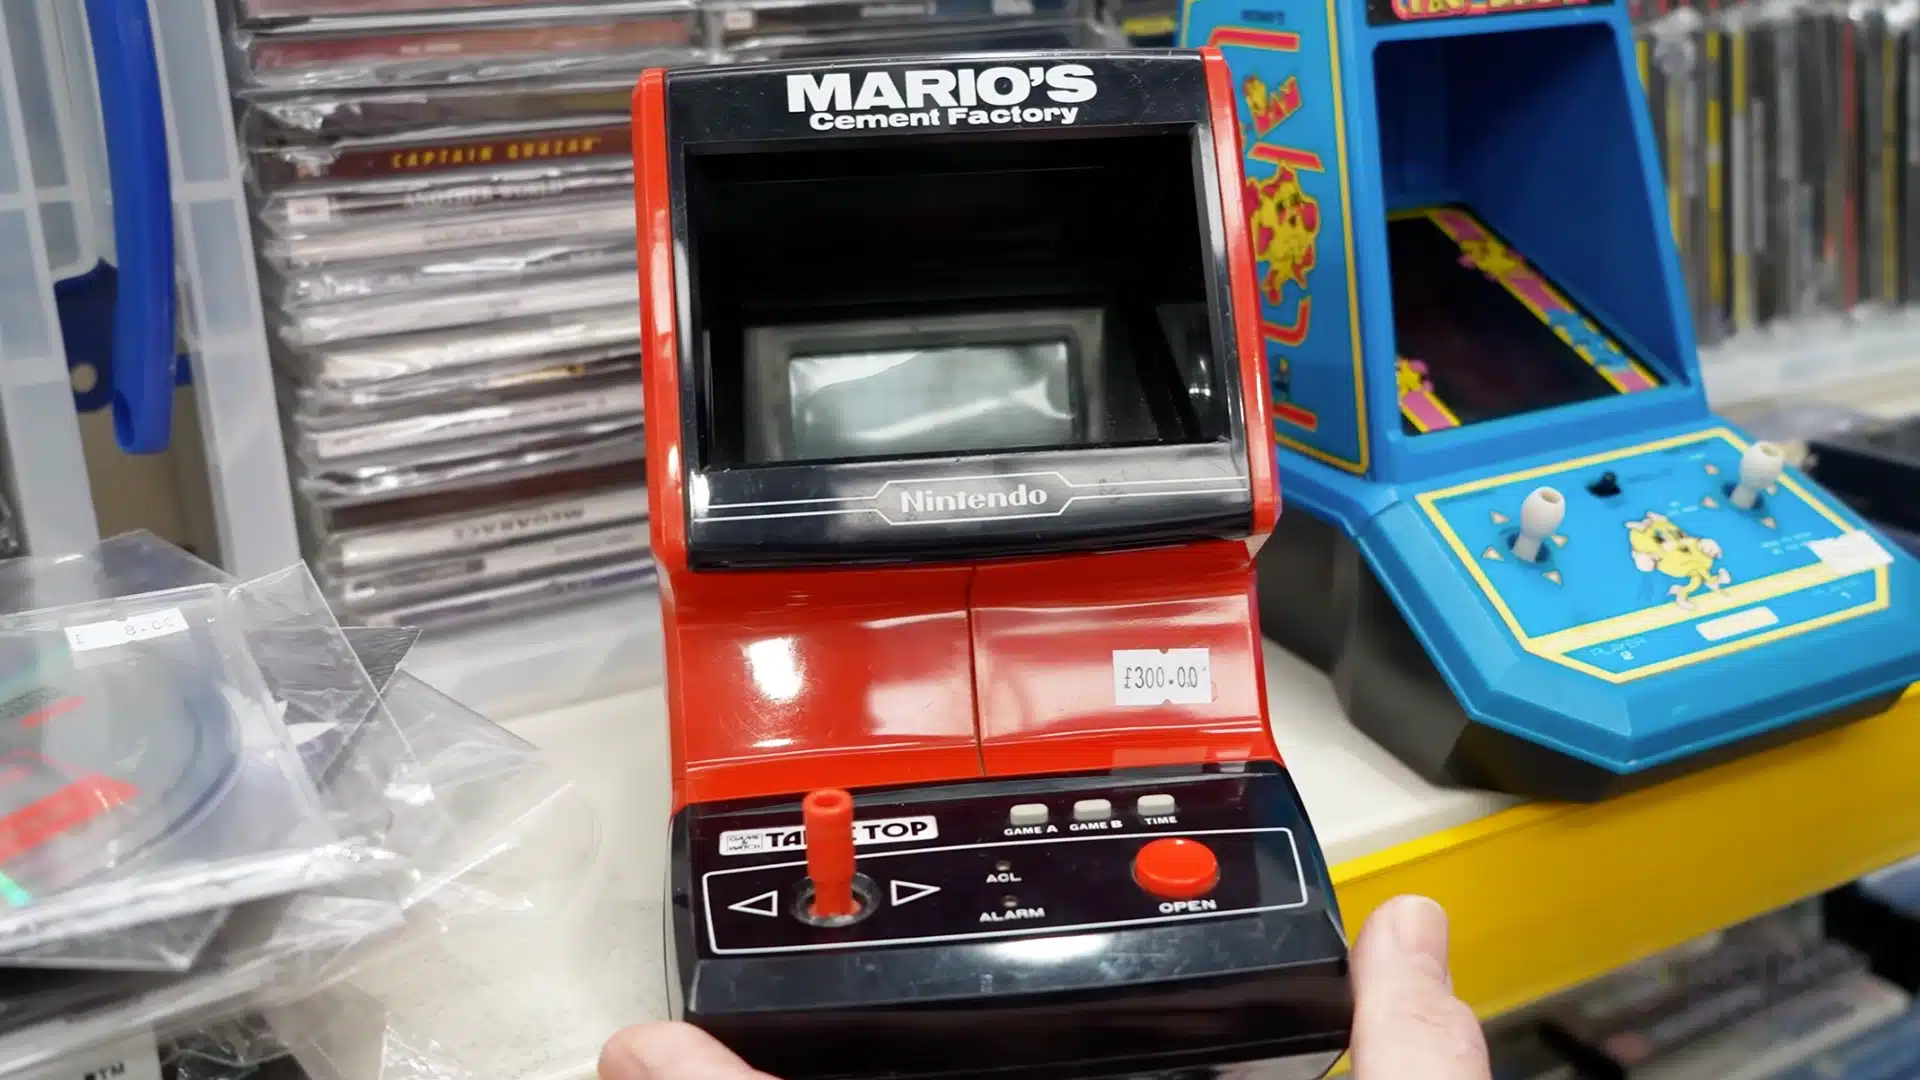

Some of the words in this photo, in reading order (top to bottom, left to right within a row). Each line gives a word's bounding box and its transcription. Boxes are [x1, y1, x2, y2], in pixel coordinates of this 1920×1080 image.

[786, 64, 1098, 113] MARIO'S
[809, 108, 940, 131] Cement
[948, 105, 1079, 126] Factory
[900, 484, 1048, 513] Nintendo
[1124, 666, 1199, 689] £300.00
[1069, 821, 1109, 831] GAME
[1110, 820, 1124, 829] B
[1144, 816, 1178, 825] TIME
[863, 821, 928, 840] TOP
[1004, 826, 1043, 836] GAME
[1046, 825, 1059, 833] A
[986, 873, 1022, 884] ACL
[1159, 899, 1217, 914] OPEN
[979, 908, 1046, 922] ALARM
